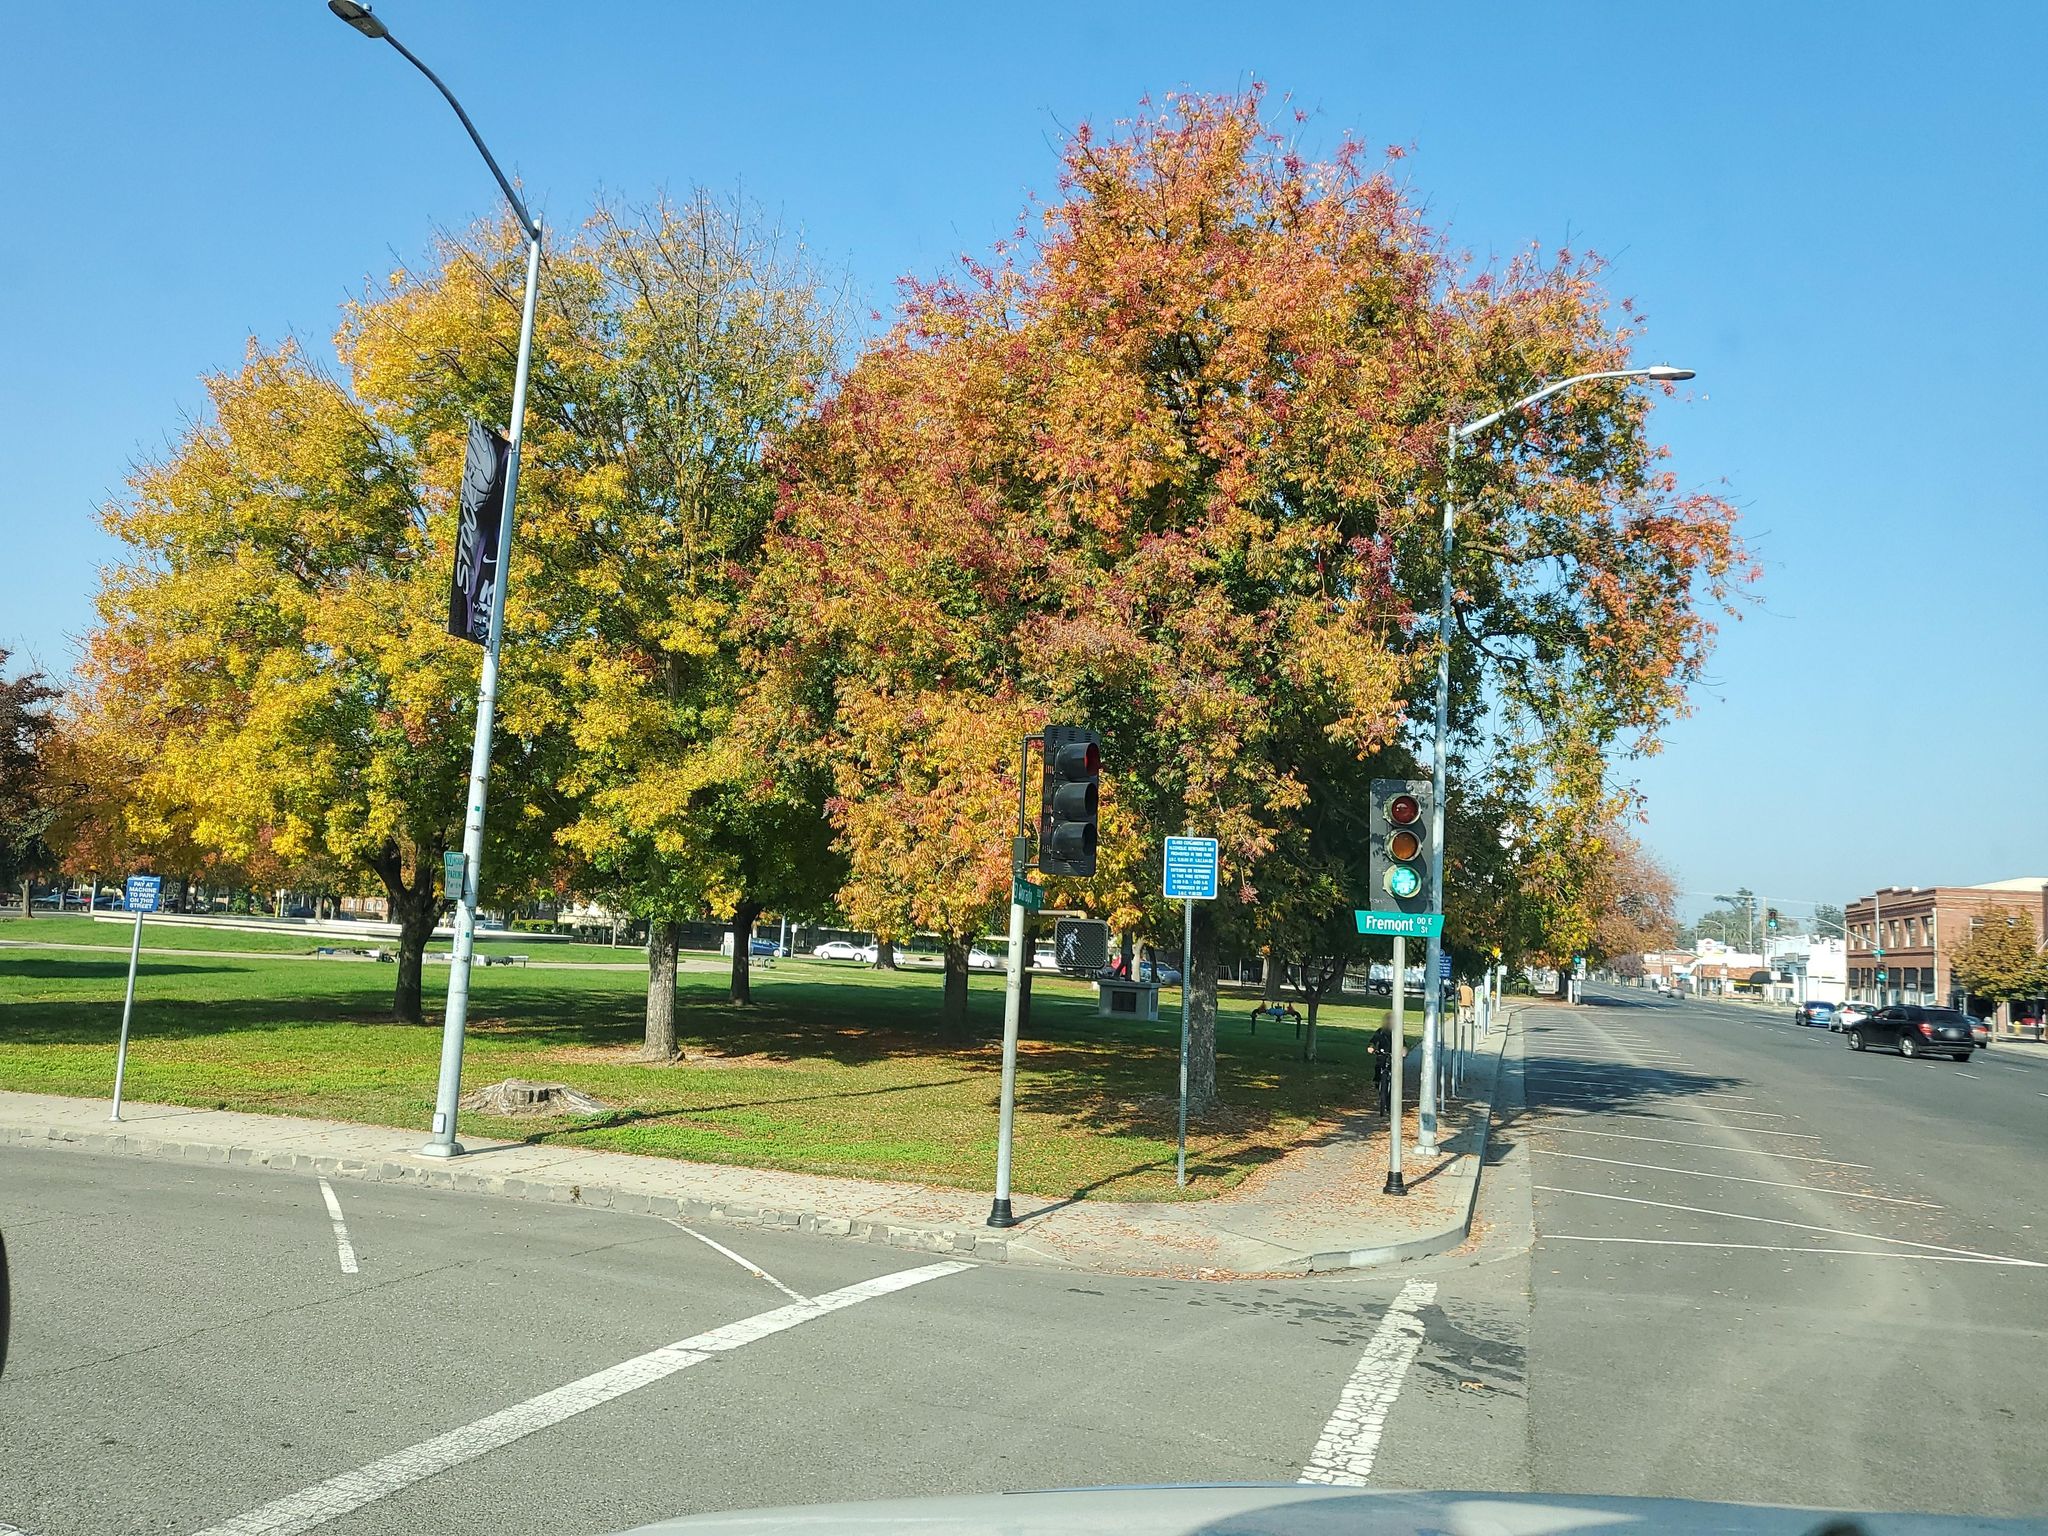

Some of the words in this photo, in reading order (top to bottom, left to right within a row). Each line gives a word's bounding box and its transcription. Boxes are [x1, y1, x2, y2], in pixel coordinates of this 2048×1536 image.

[1366, 915, 1414, 931] Fremont
[1428, 917, 1433, 925] E
[1420, 926, 1428, 934] St
